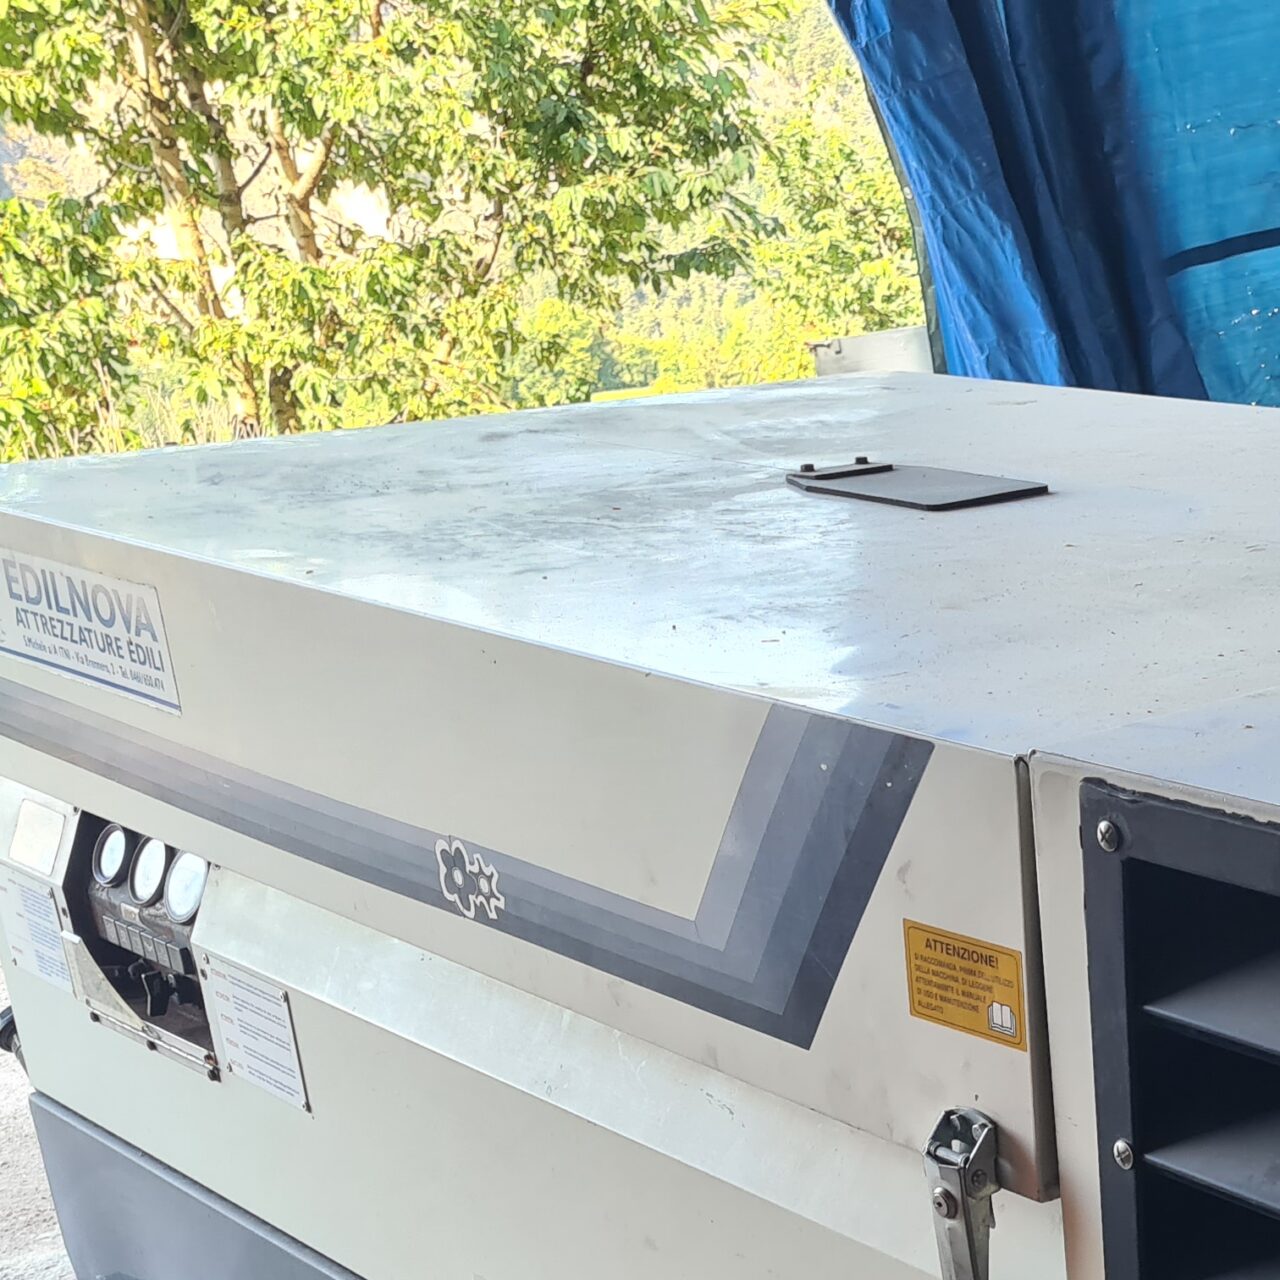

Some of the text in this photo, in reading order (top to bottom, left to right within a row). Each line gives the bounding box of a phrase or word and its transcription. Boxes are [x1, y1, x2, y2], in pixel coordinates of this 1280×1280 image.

[2, 559, 158, 643] EDILNOVA
[15, 606, 165, 673] ATTREZZATURE EDILI
[925, 937, 999, 969] ATTENZIONE!
